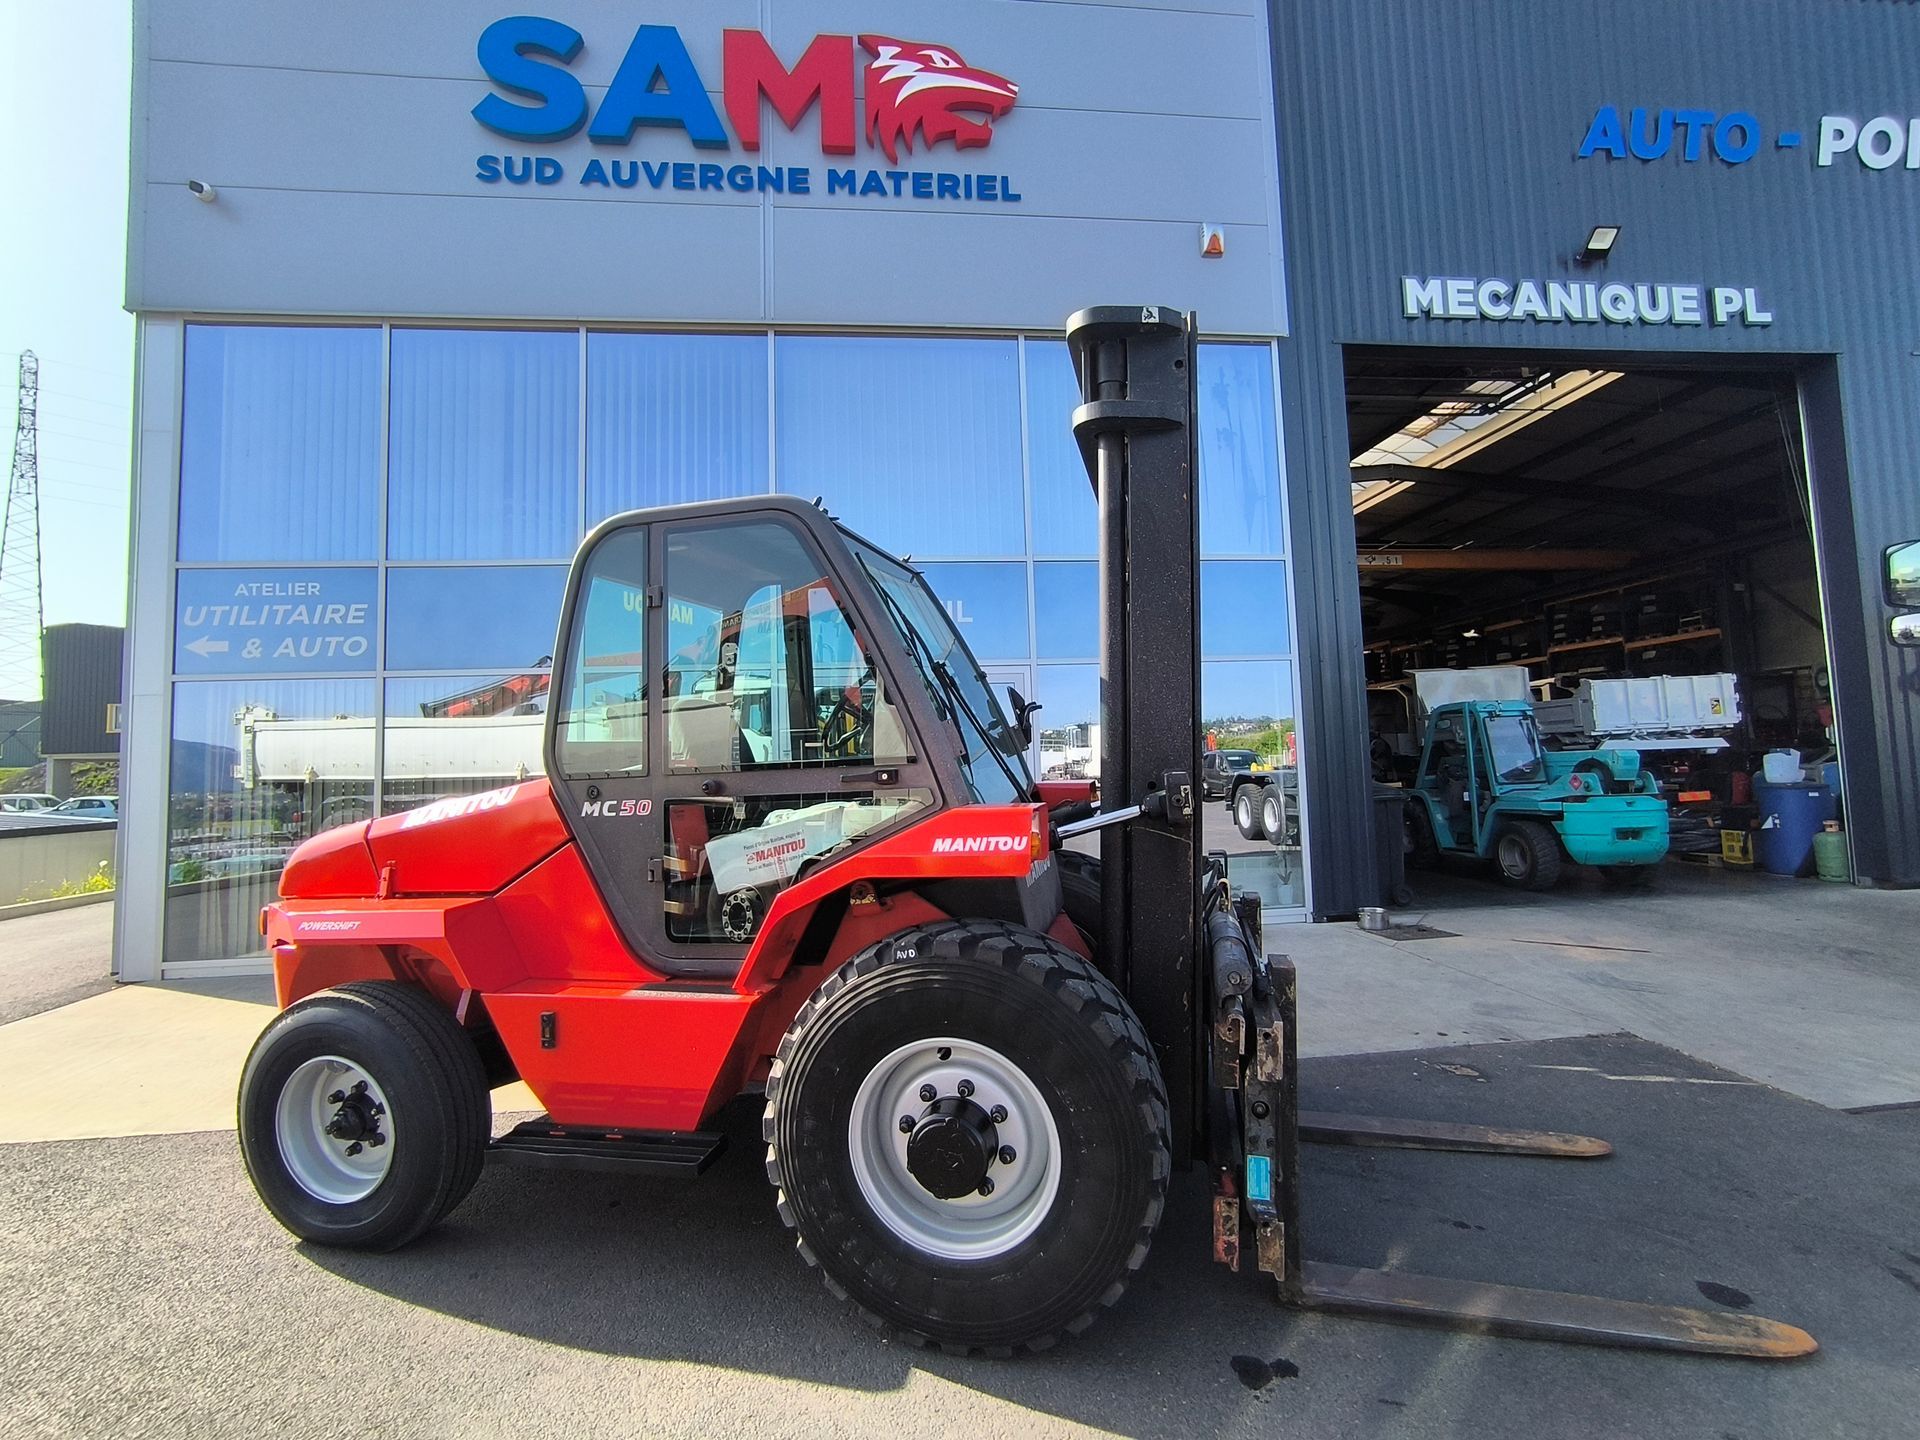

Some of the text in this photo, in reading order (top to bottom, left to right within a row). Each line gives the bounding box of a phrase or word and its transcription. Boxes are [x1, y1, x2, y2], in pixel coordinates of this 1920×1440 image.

[471, 16, 856, 155] SAM
[1579, 106, 1761, 164] AUTO
[1778, 131, 1800, 148] -
[476, 154, 1021, 201] SUD AUVERGNE MATERIEL
[1402, 275, 1773, 326] MECANIQUE PL
[234, 582, 321, 597] ATELIER
[183, 603, 368, 626] UTILITAIRE
[241, 636, 368, 659] & AUTO
[755, 838, 806, 862] MANITOU
[931, 836, 1028, 853] MANITOU
[298, 920, 361, 931] POWERSHIFT
